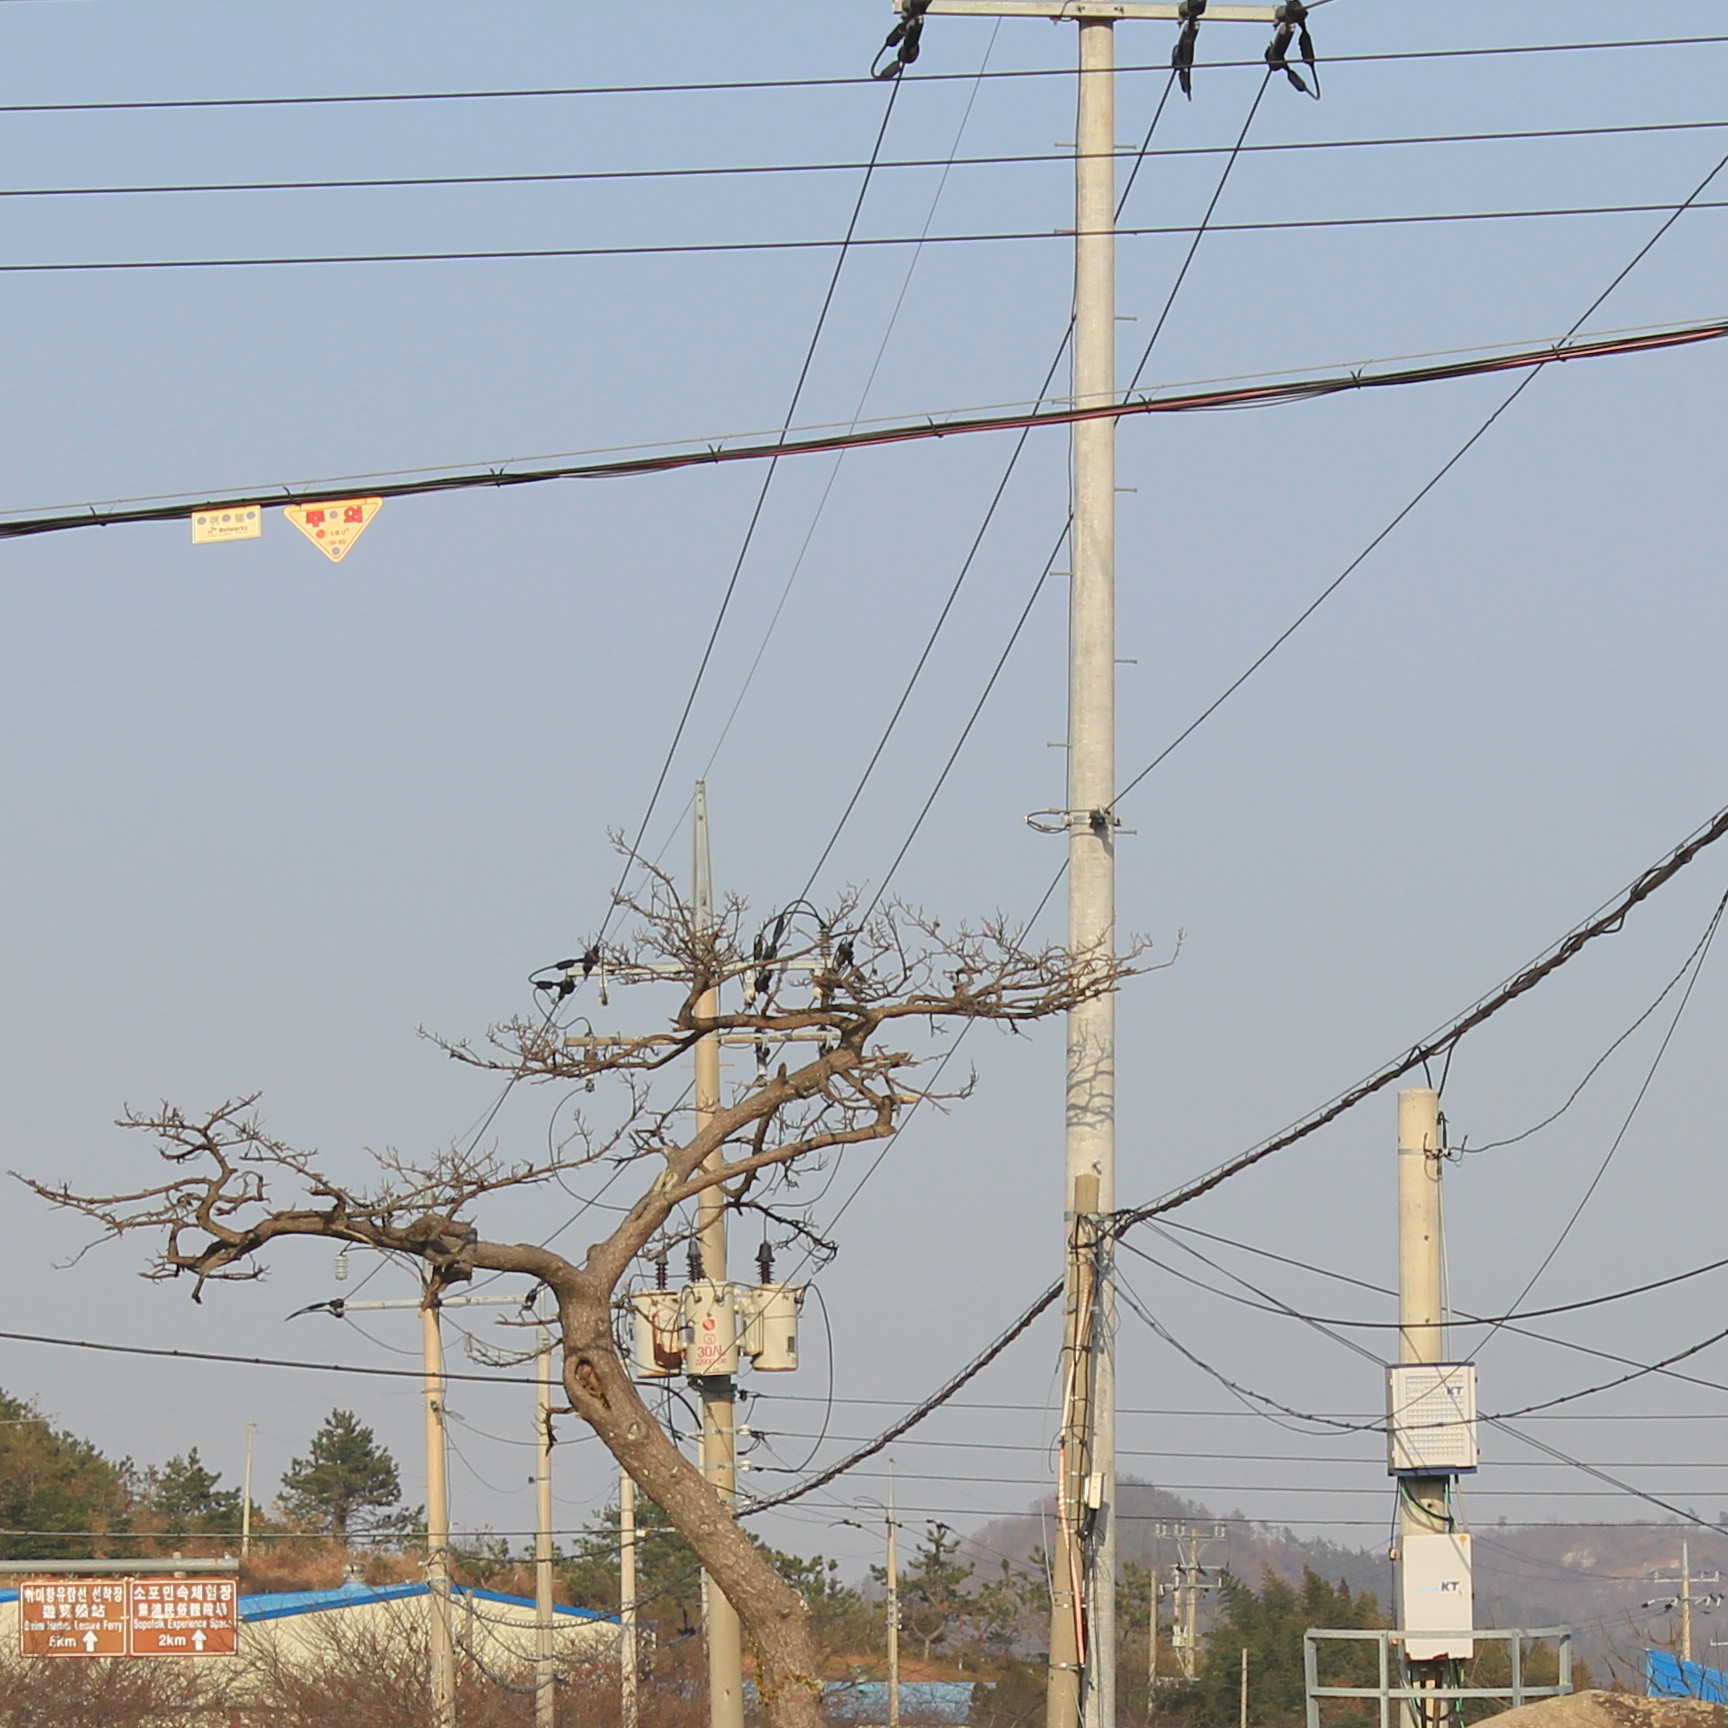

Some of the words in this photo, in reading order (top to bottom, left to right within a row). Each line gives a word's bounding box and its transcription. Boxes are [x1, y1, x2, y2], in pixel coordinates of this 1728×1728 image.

[1446, 1386, 1464, 1396] KT
[133, 1584, 232, 1601] 소포민속체험장
[1441, 1581, 1460, 1592] KT
[103, 1619, 123, 1633] Ferry
[167, 1618, 208, 1631] Experience
[158, 1633, 187, 1646] 2km
